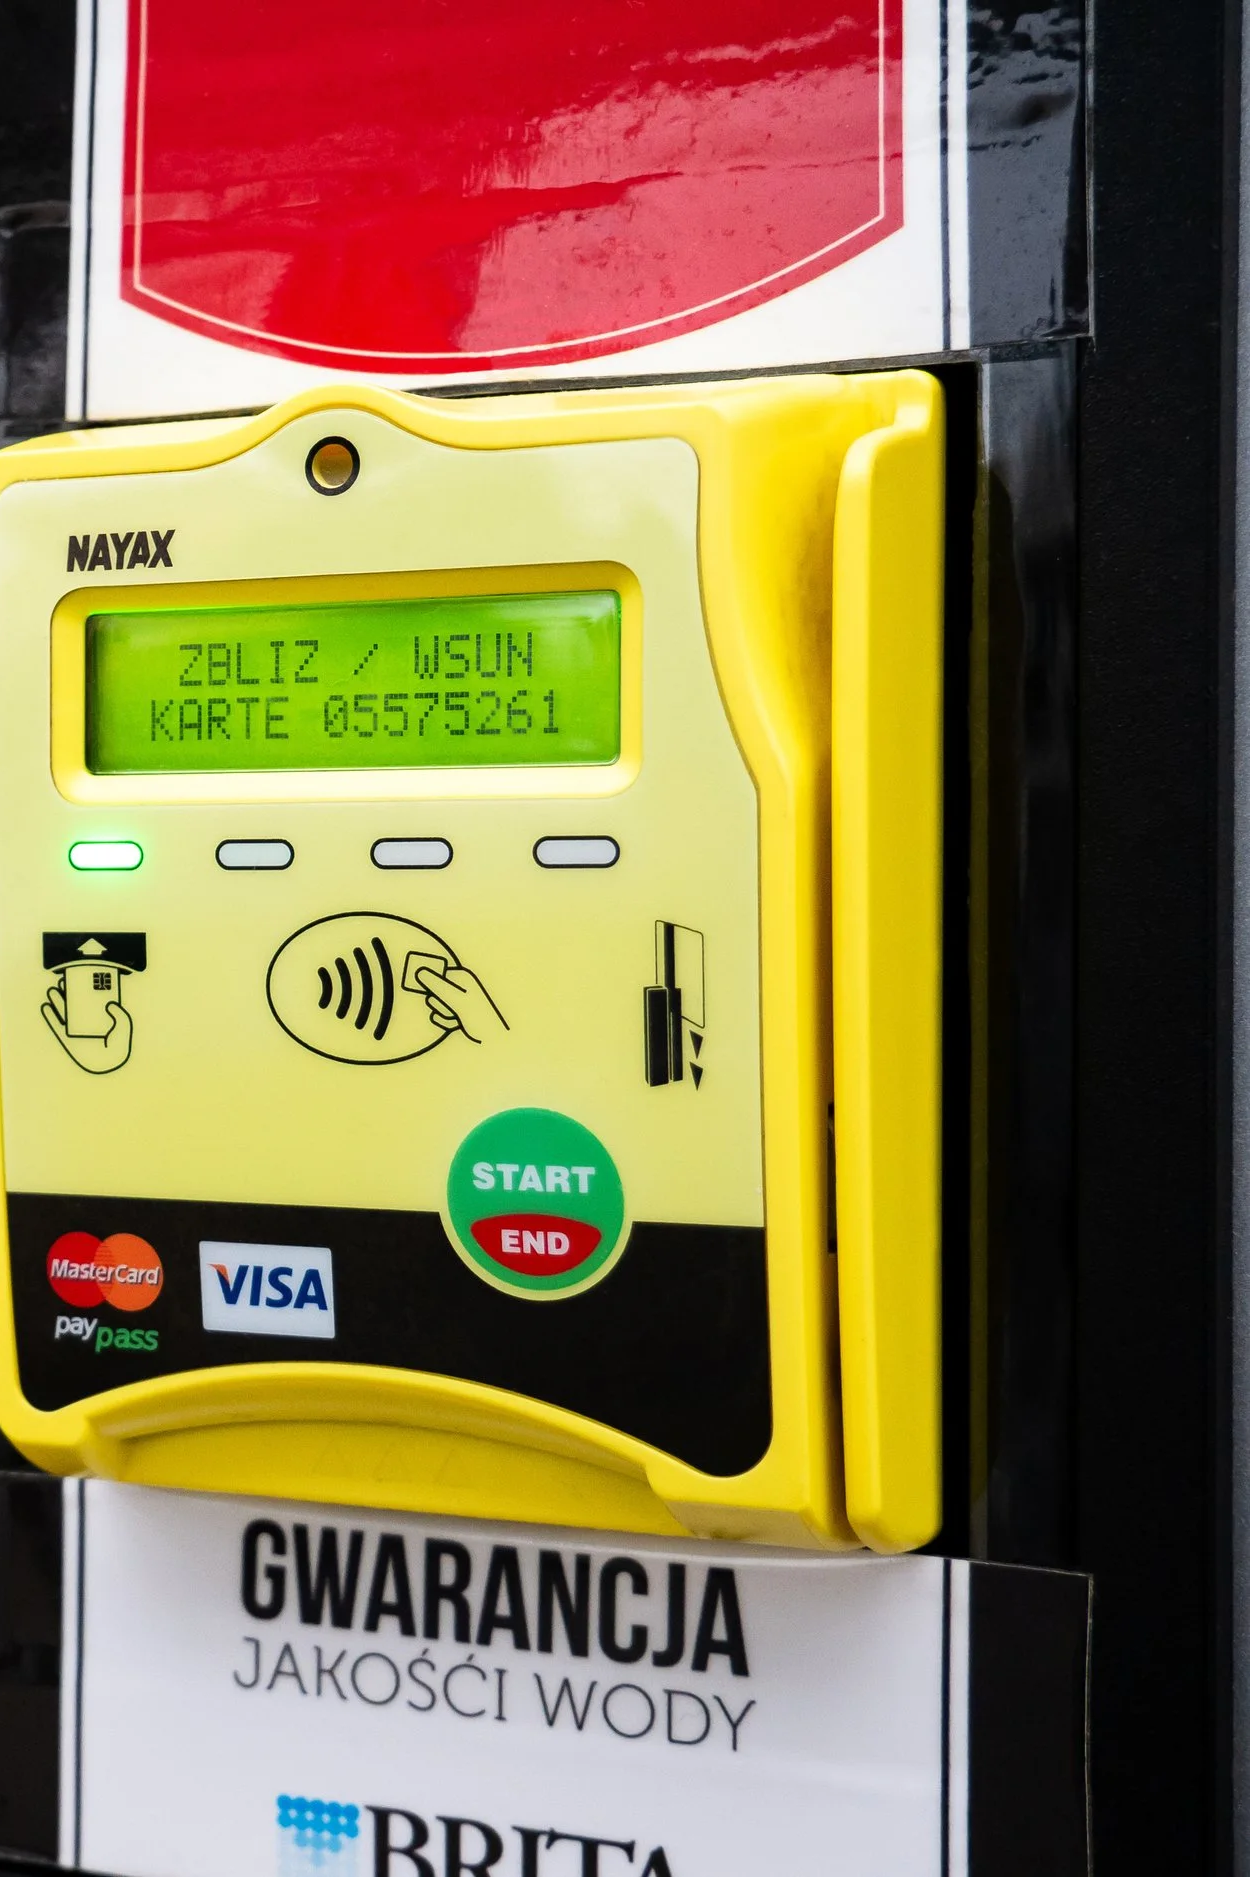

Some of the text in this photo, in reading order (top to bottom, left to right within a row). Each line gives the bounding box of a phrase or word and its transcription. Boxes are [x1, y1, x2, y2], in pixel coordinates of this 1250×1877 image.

[66, 529, 175, 571] NAYAX
[178, 639, 319, 686] ZBLIZ
[414, 631, 533, 679] WSUN
[150, 689, 559, 741] KARTE 05575261
[472, 1162, 595, 1194] START
[501, 1229, 570, 1256] END
[51, 1258, 160, 1286] MasterCard
[208, 1263, 329, 1311] VISA
[240, 1518, 751, 1679] GWARANCJA
[233, 1636, 756, 1753] JAKOŚĆI WODY
